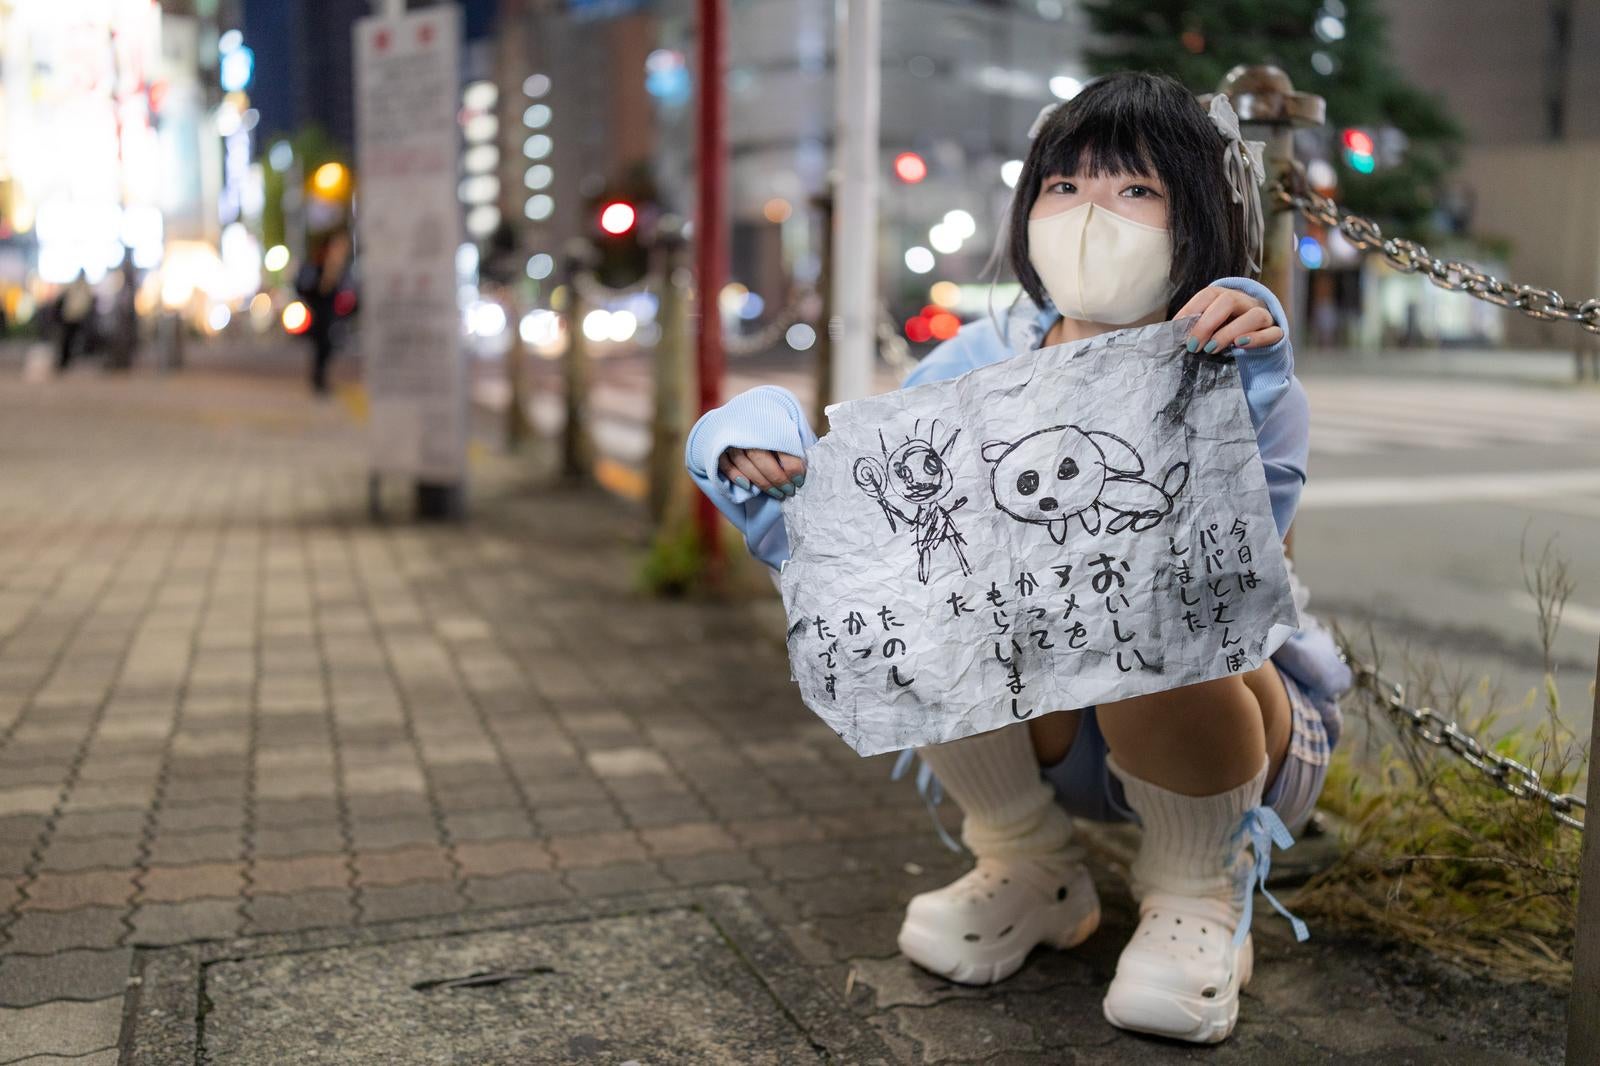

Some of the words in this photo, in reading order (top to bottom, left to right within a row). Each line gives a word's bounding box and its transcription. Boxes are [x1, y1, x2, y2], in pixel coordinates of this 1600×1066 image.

[1169, 537, 1207, 632] しました
[1229, 517, 1261, 592] 今日は
[842, 611, 871, 659] かっ
[946, 592, 975, 617] た
[1015, 572, 1054, 649] かって
[1088, 553, 1147, 672] おいしい
[813, 615, 838, 700] たです
[877, 605, 915, 687] たのし
[986, 581, 1033, 720] もらいまし
